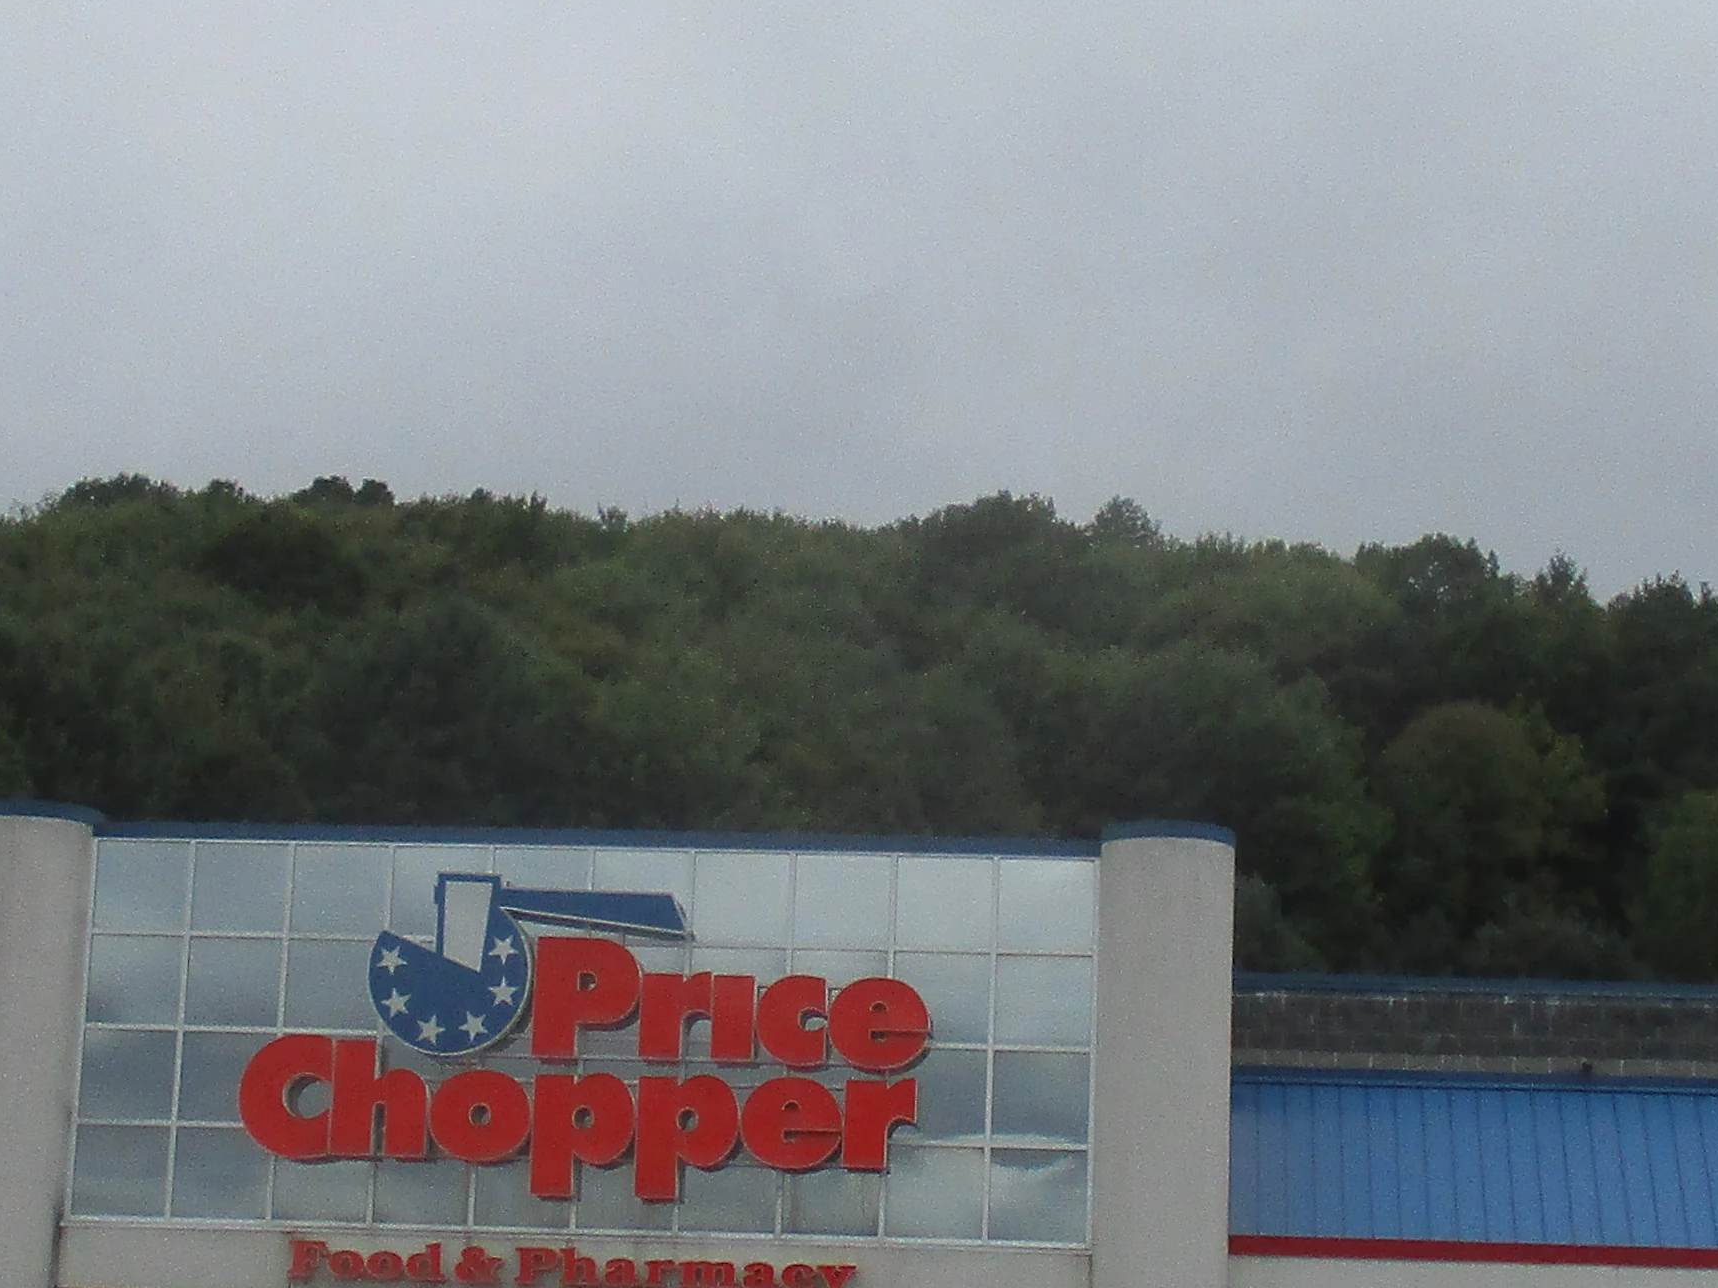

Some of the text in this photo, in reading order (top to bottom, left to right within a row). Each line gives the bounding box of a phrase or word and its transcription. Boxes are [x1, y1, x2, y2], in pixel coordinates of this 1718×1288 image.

[531, 936, 931, 1073] Price
[238, 1033, 918, 1201] Chopper
[288, 1240, 447, 1283] Food
[455, 1246, 502, 1286] &
